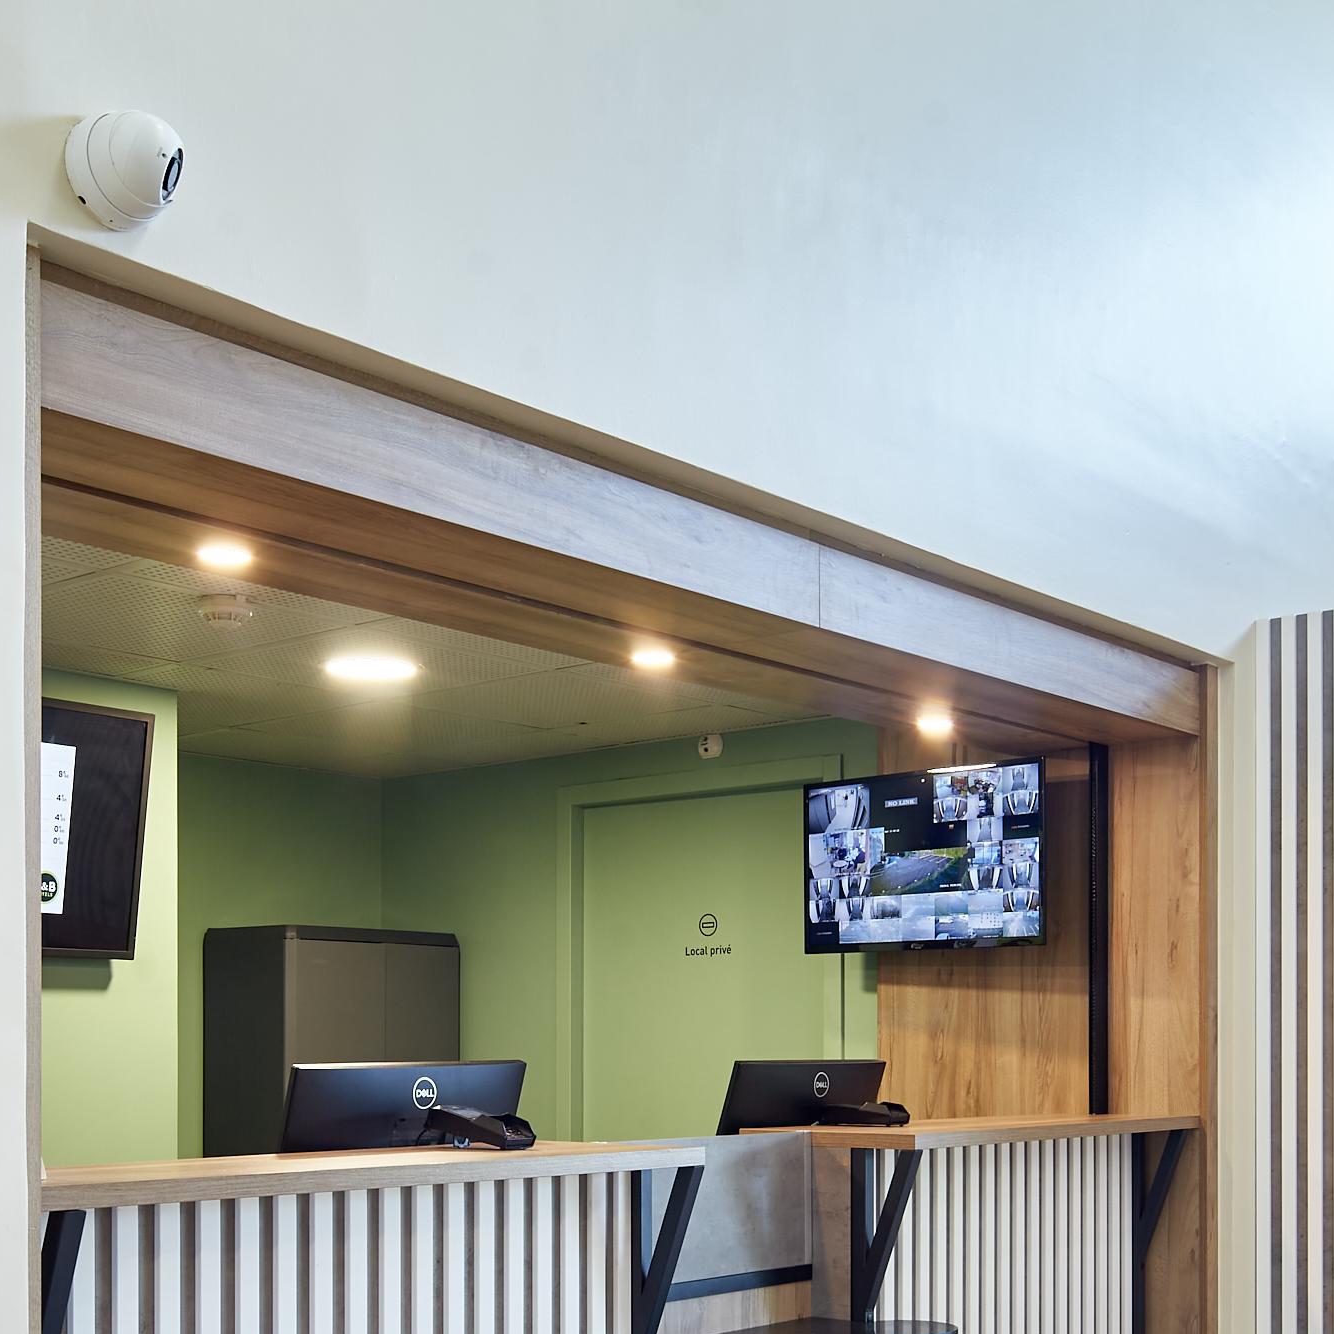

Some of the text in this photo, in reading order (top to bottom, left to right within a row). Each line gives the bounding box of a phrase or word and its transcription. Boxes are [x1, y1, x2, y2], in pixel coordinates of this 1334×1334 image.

[685, 944, 732, 957] Local privé
[815, 1081, 828, 1089] DELL
[415, 1088, 435, 1098] DELL
